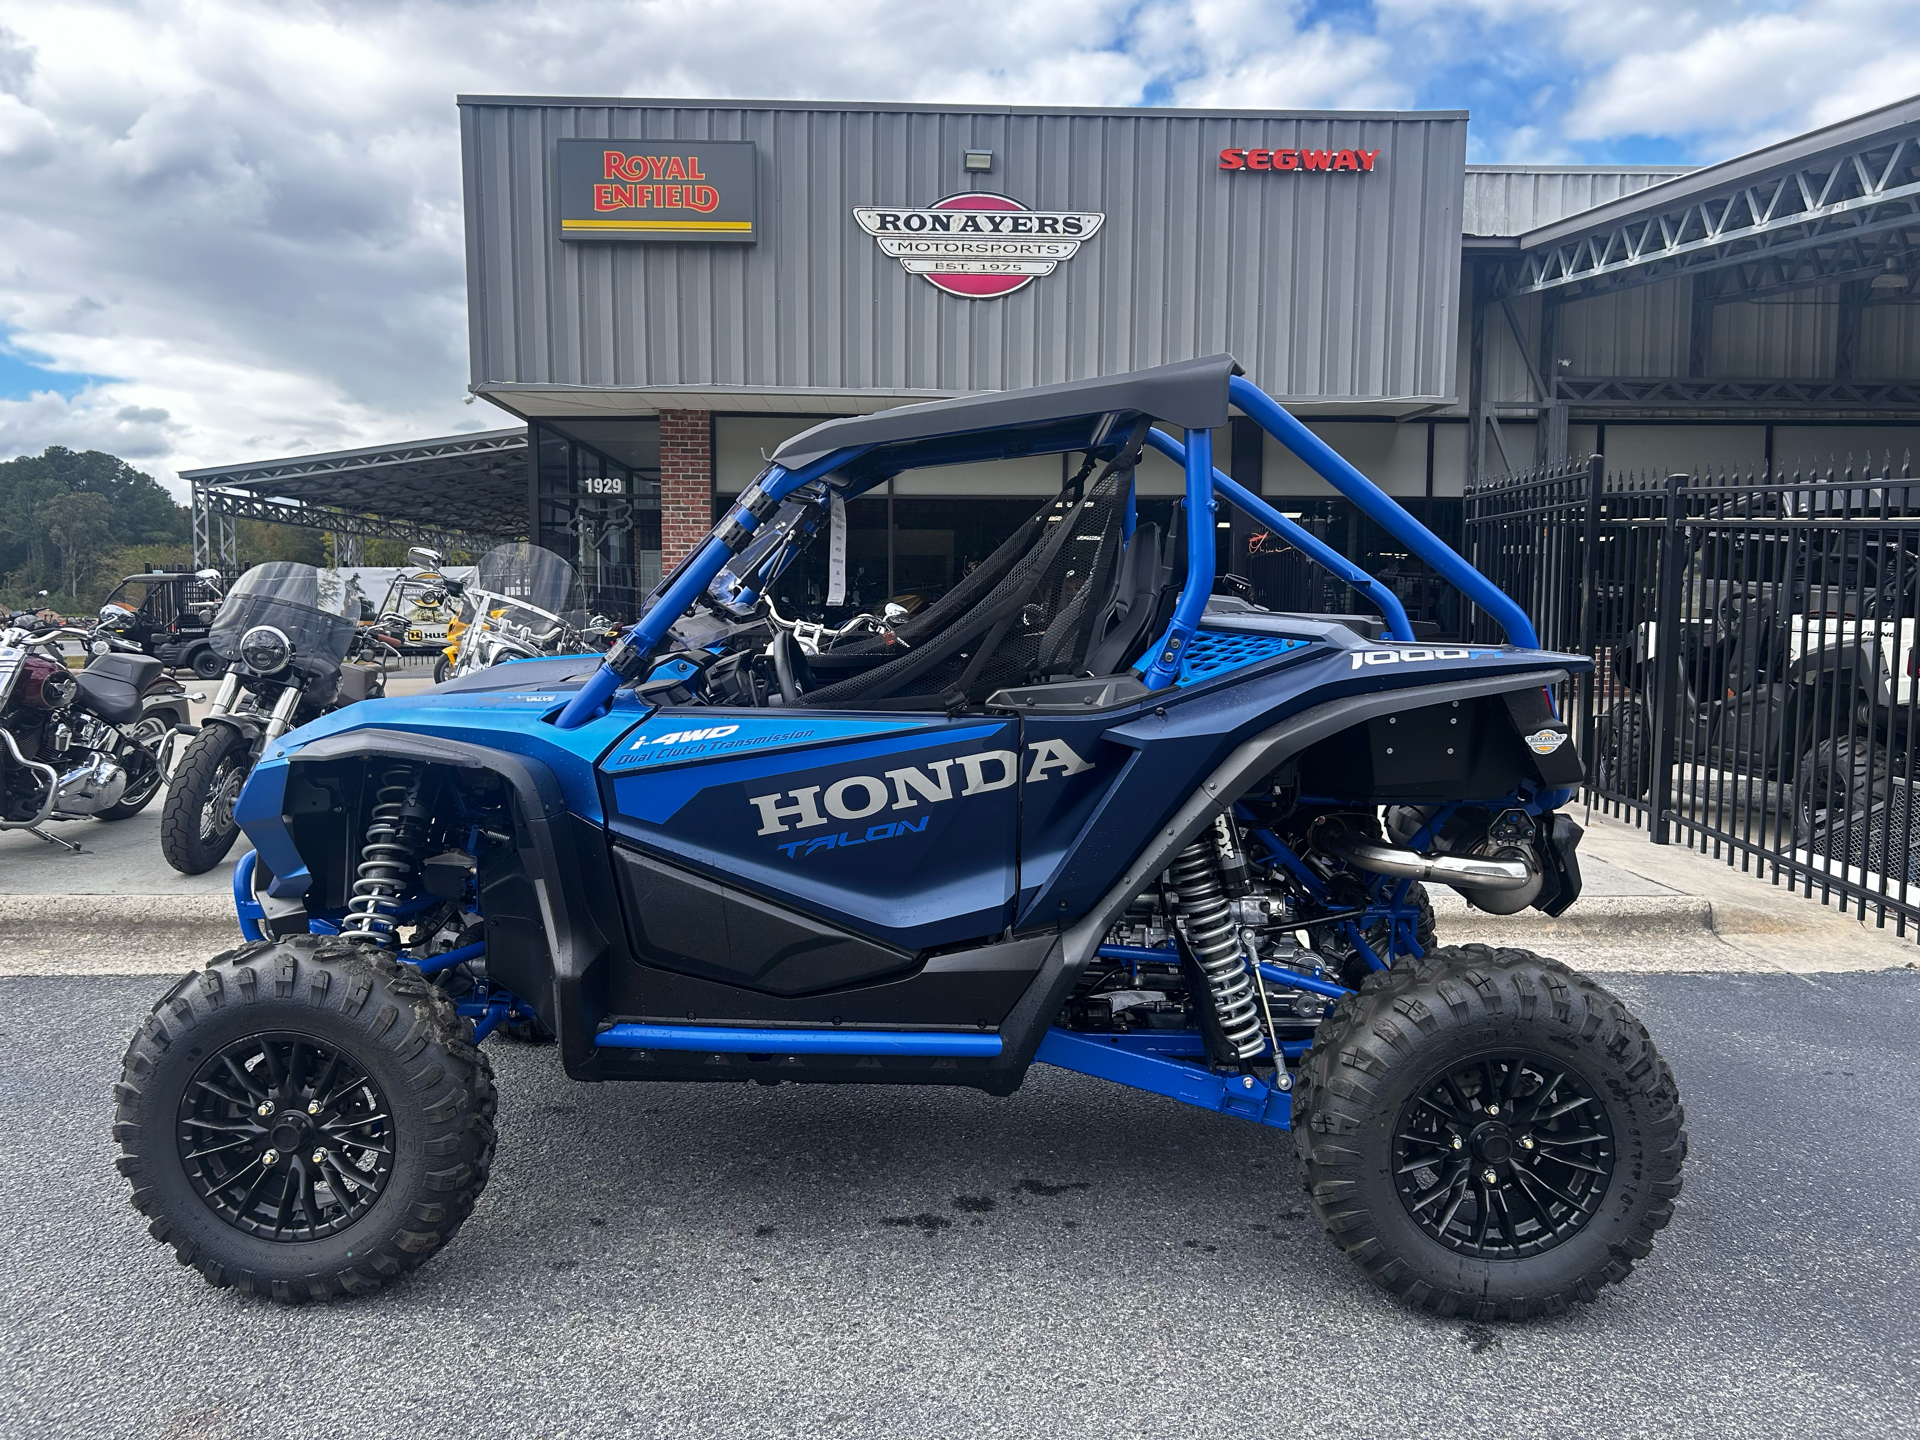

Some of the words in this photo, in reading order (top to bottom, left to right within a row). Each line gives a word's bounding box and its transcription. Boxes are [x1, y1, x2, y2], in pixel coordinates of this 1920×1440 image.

[603, 151, 705, 182] ROYAL
[1219, 148, 1381, 170] SEGWAY
[594, 184, 720, 213] ENFIELD
[876, 213, 954, 232] RON
[957, 214, 1083, 234] AYERS
[897, 242, 1059, 254] MOTORSPORTS
[935, 262, 971, 270] EST.
[980, 263, 1022, 271] 1975
[585, 478, 622, 493] 1929
[615, 750, 656, 766] Dual
[656, 743, 706, 759] Clutch
[709, 729, 815, 751] Transmission
[629, 724, 740, 750] i-4WD
[750, 738, 1095, 836] HONDA
[777, 815, 929, 859] TALON
